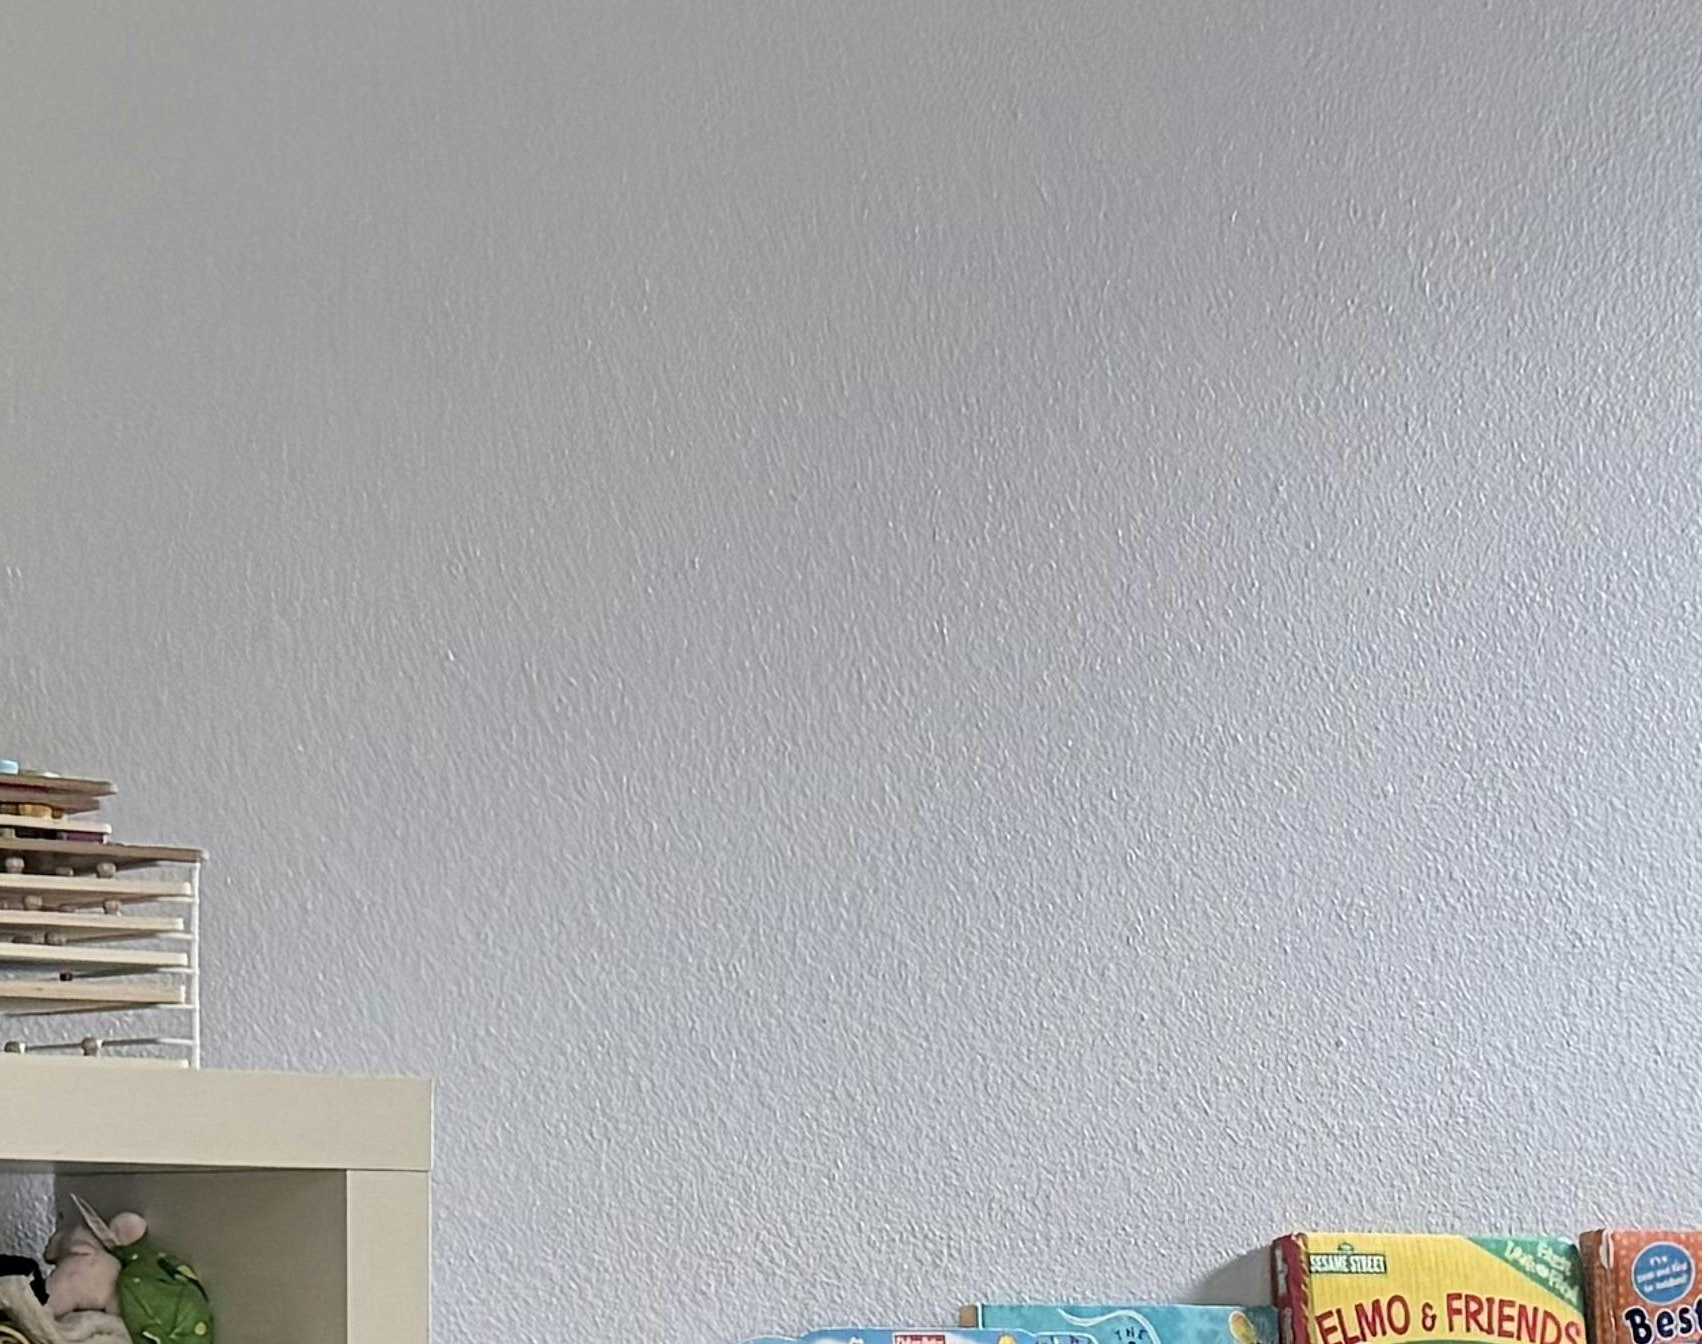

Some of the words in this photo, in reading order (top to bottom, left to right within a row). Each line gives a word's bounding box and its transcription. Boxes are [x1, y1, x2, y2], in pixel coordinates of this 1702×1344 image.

[1309, 1255, 1347, 1273] SESAME
[1348, 1254, 1386, 1272] STREET
[1422, 1302, 1437, 1331] &
